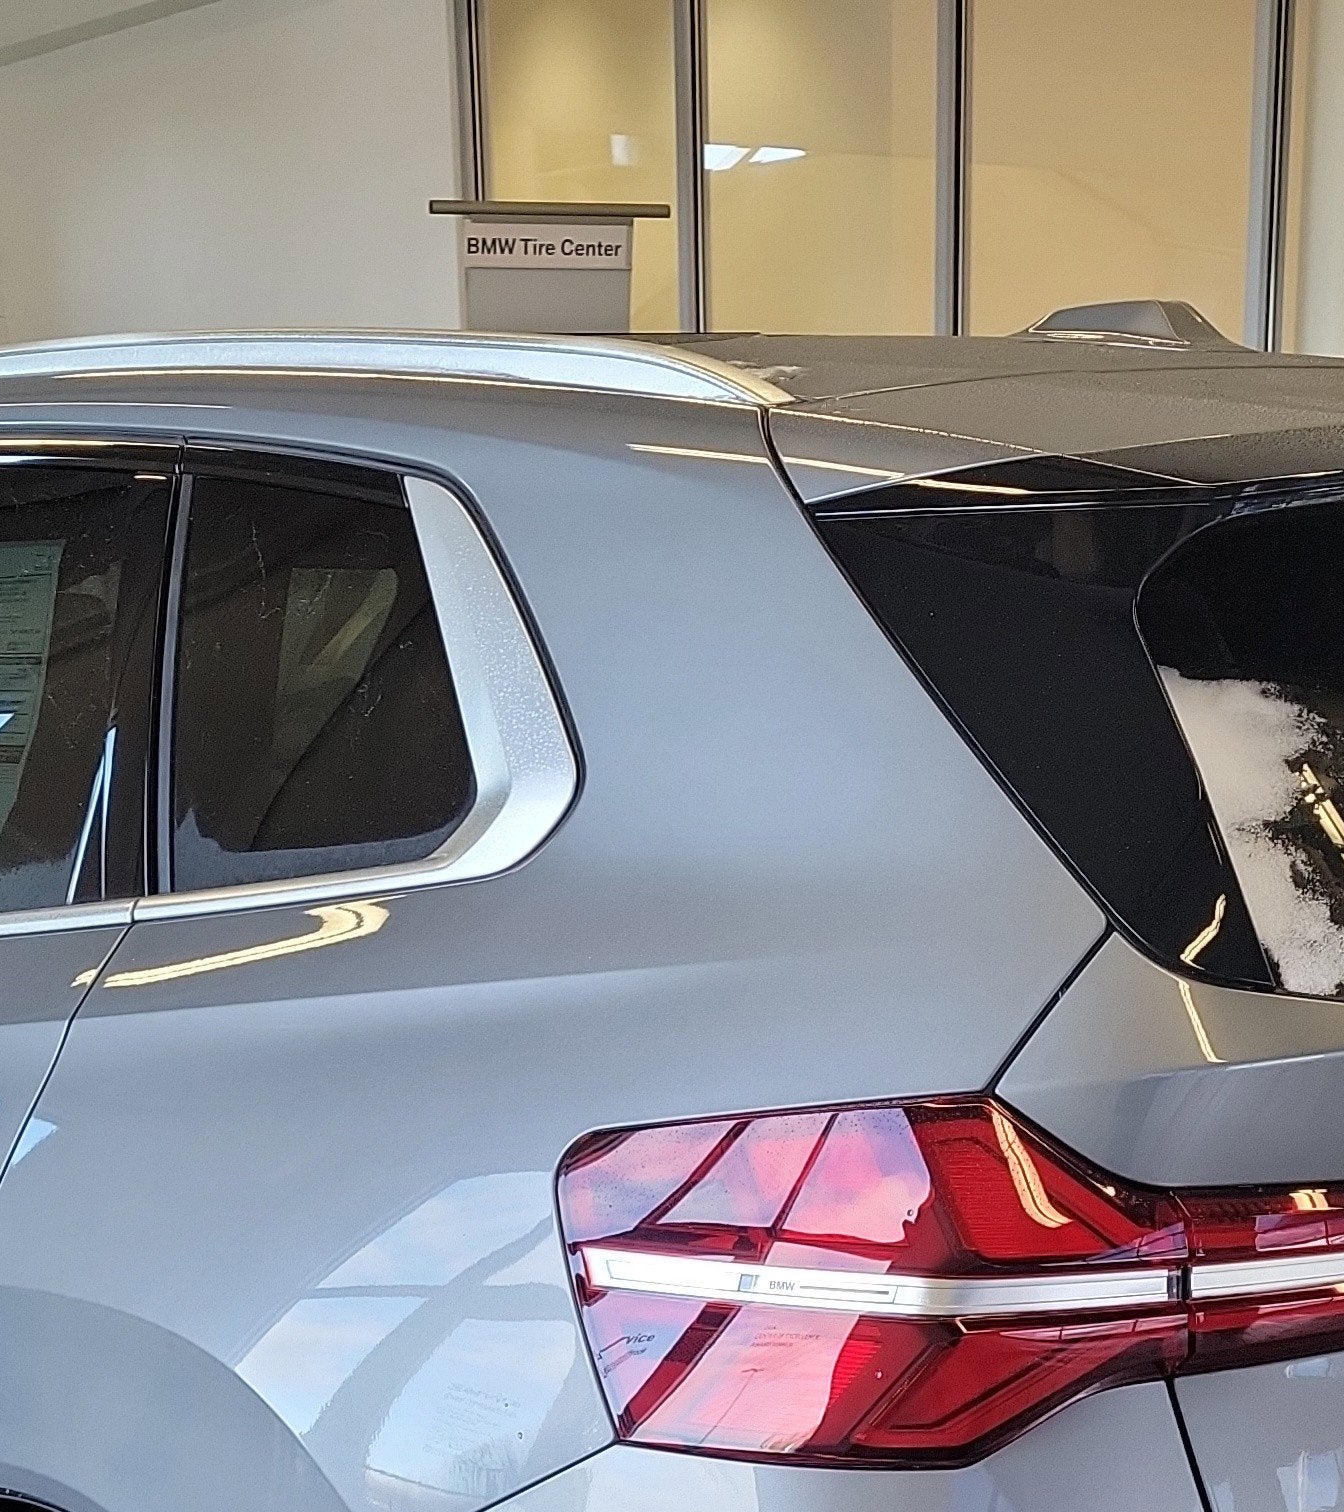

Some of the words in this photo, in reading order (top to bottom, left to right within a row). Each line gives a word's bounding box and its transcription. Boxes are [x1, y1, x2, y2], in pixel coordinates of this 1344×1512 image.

[466, 237, 516, 255] BMW
[520, 238, 556, 256] Tire
[560, 239, 622, 257] Center
[769, 1280, 795, 1291] BMW
